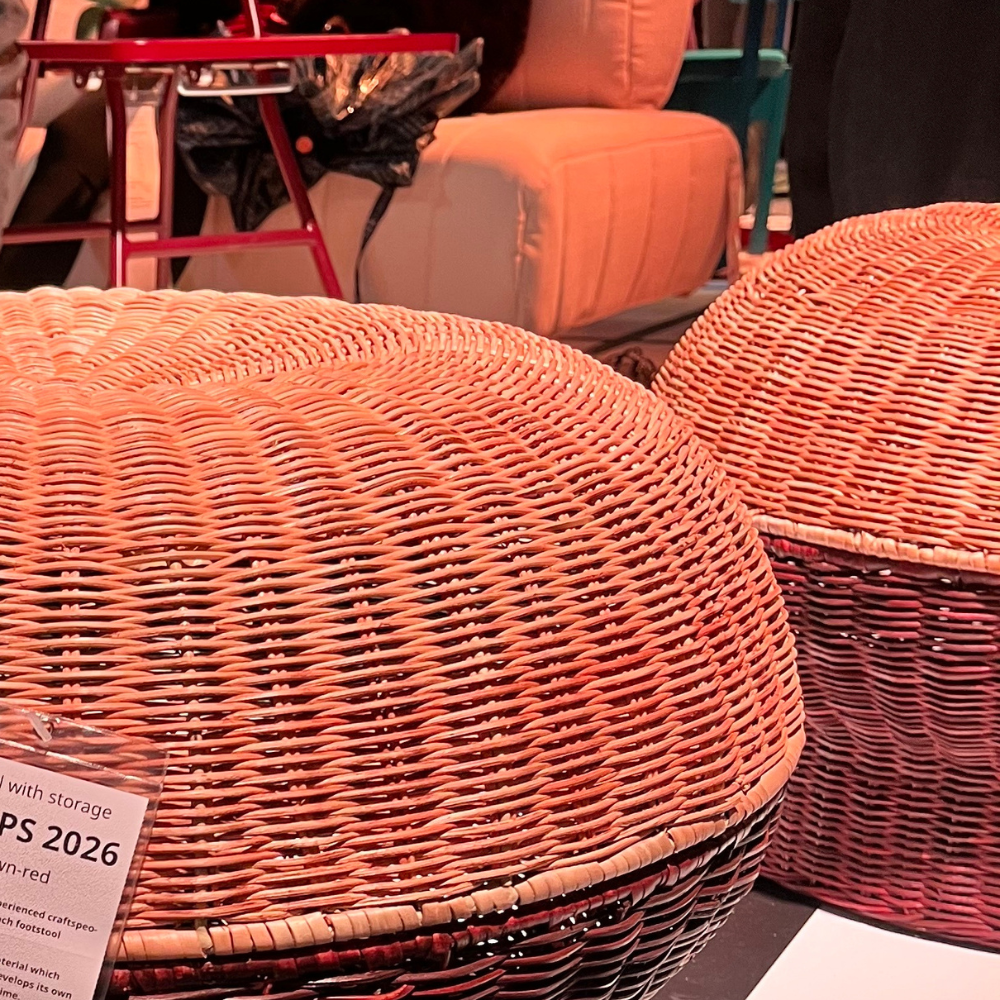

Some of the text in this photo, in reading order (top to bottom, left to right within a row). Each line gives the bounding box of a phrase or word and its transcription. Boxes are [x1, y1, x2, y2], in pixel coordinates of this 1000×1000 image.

[8, 781, 44, 801] with
[47, 792, 112, 821] storage
[41, 825, 121, 867] 2026
[15, 919, 62, 939] footstool
[47, 914, 98, 933] craftspeo-
[30, 966, 60, 981] which
[36, 982, 49, 993] its
[51, 988, 72, 1000] own
